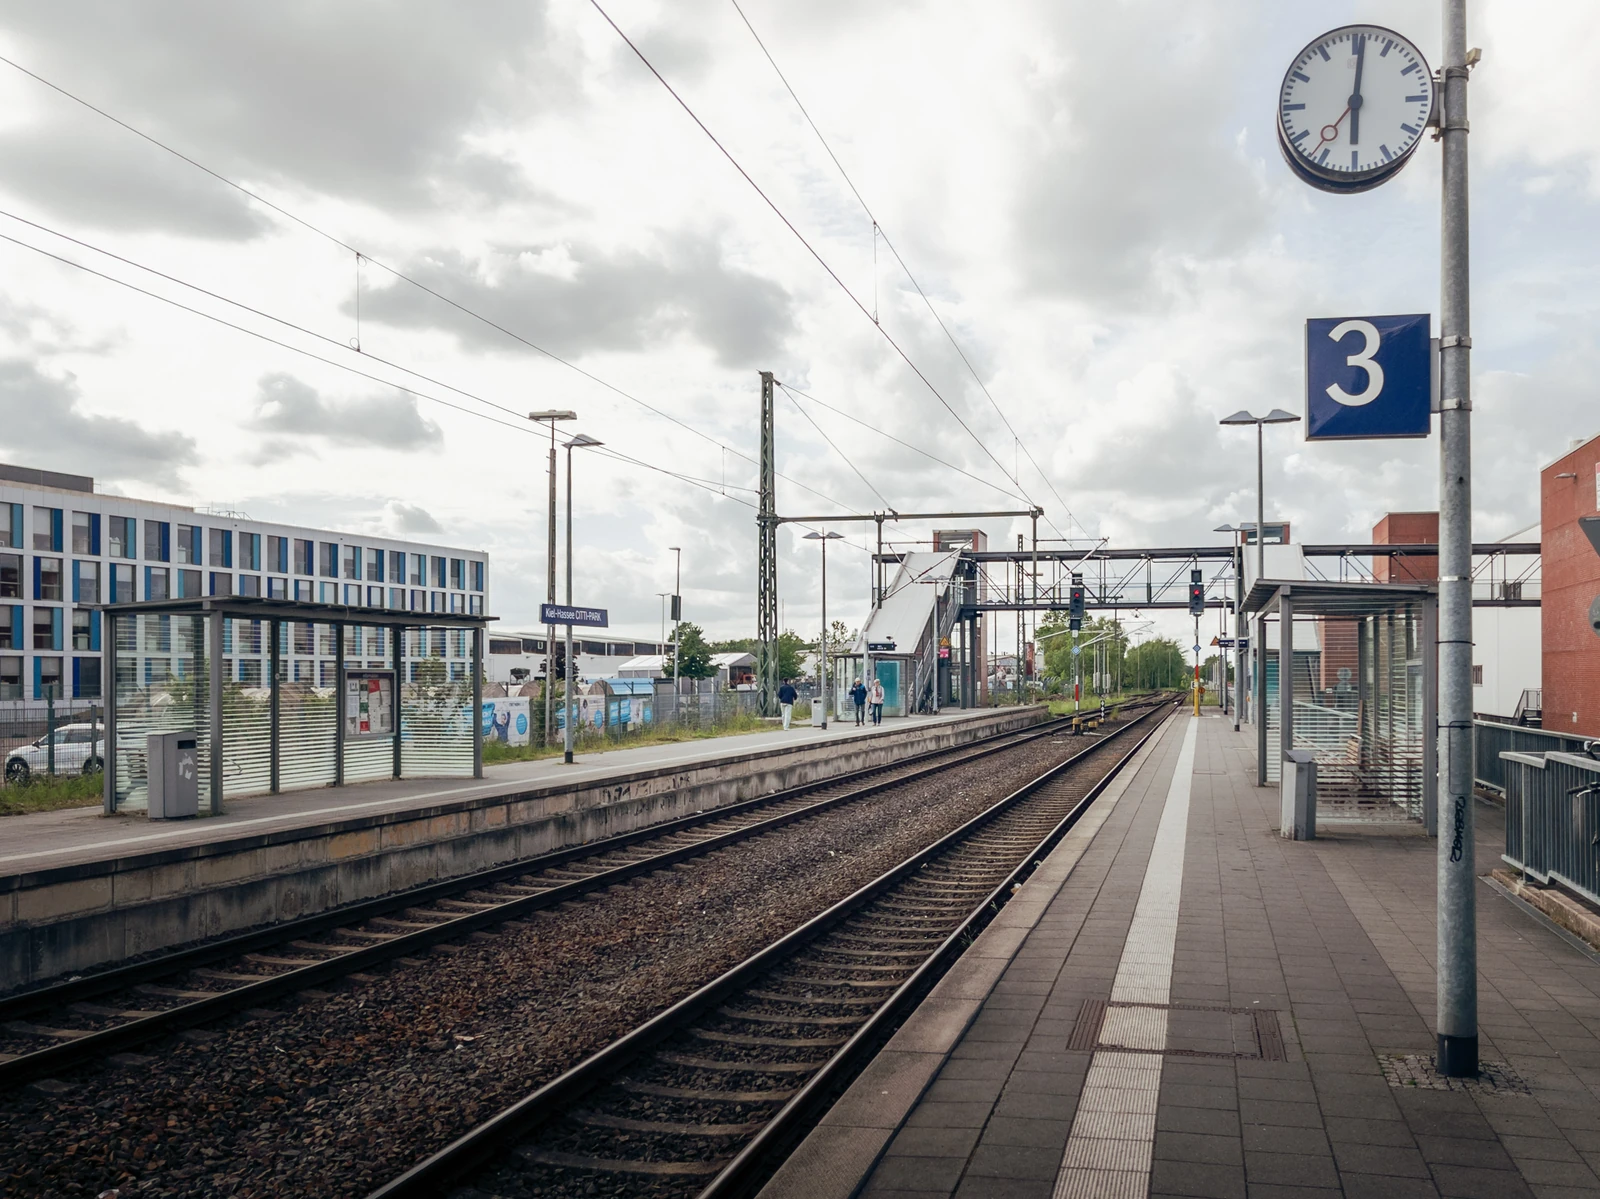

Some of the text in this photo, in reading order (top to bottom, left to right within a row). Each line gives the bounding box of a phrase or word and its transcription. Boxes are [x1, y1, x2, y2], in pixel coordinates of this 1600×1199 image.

[1325, 319, 1385, 407] 3
[545, 607, 602, 622] Kiel-Hassee CITTI-PARK
